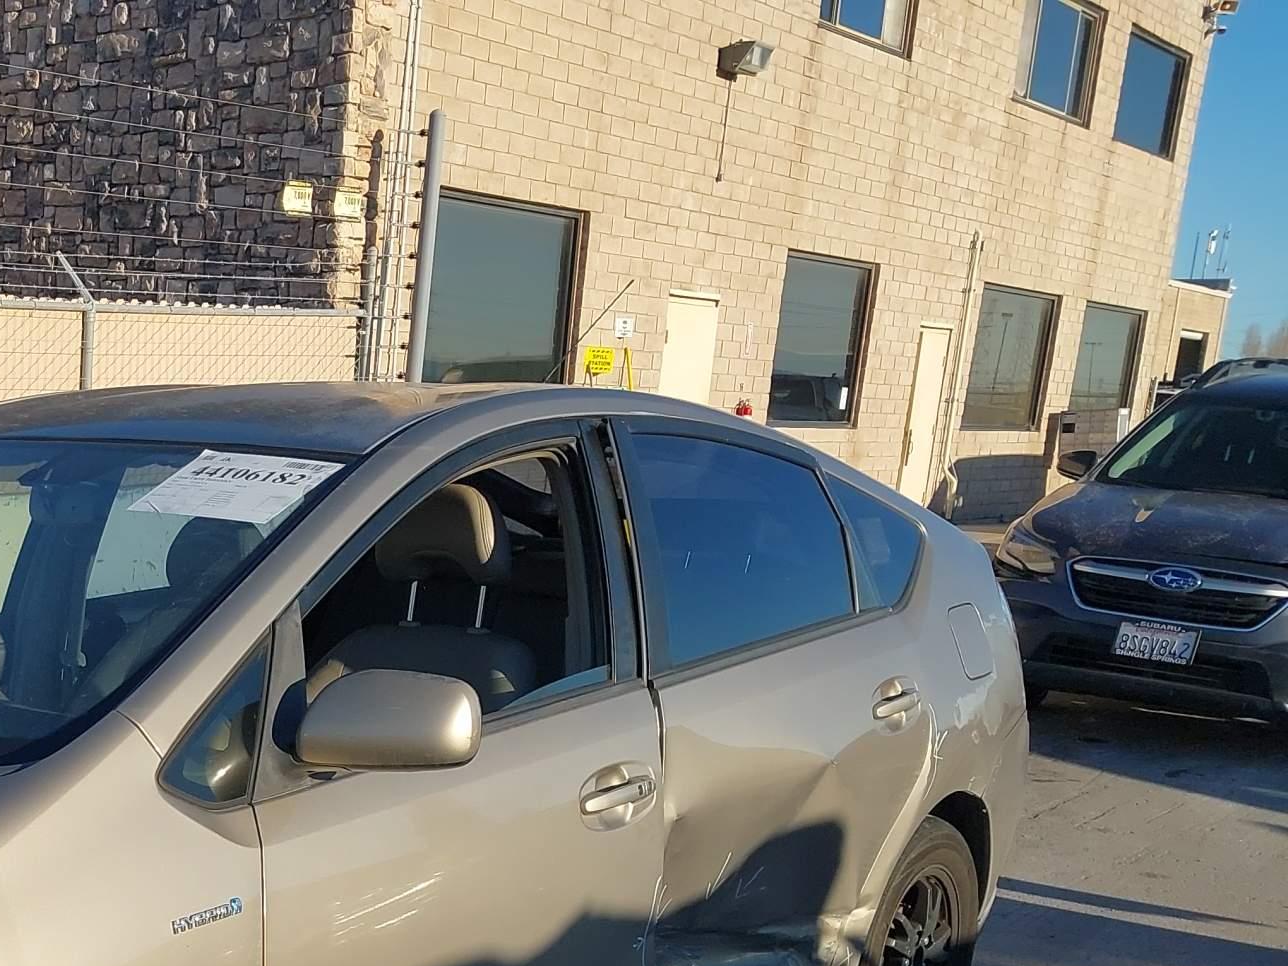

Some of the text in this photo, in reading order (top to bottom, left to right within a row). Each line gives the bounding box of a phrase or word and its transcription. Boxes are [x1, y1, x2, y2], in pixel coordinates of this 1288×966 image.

[191, 466, 307, 486] 44106182
[1140, 621, 1182, 633] SUBARU
[1115, 648, 1150, 660] SHINGLE
[1119, 634, 1190, 660] 8SGV842
